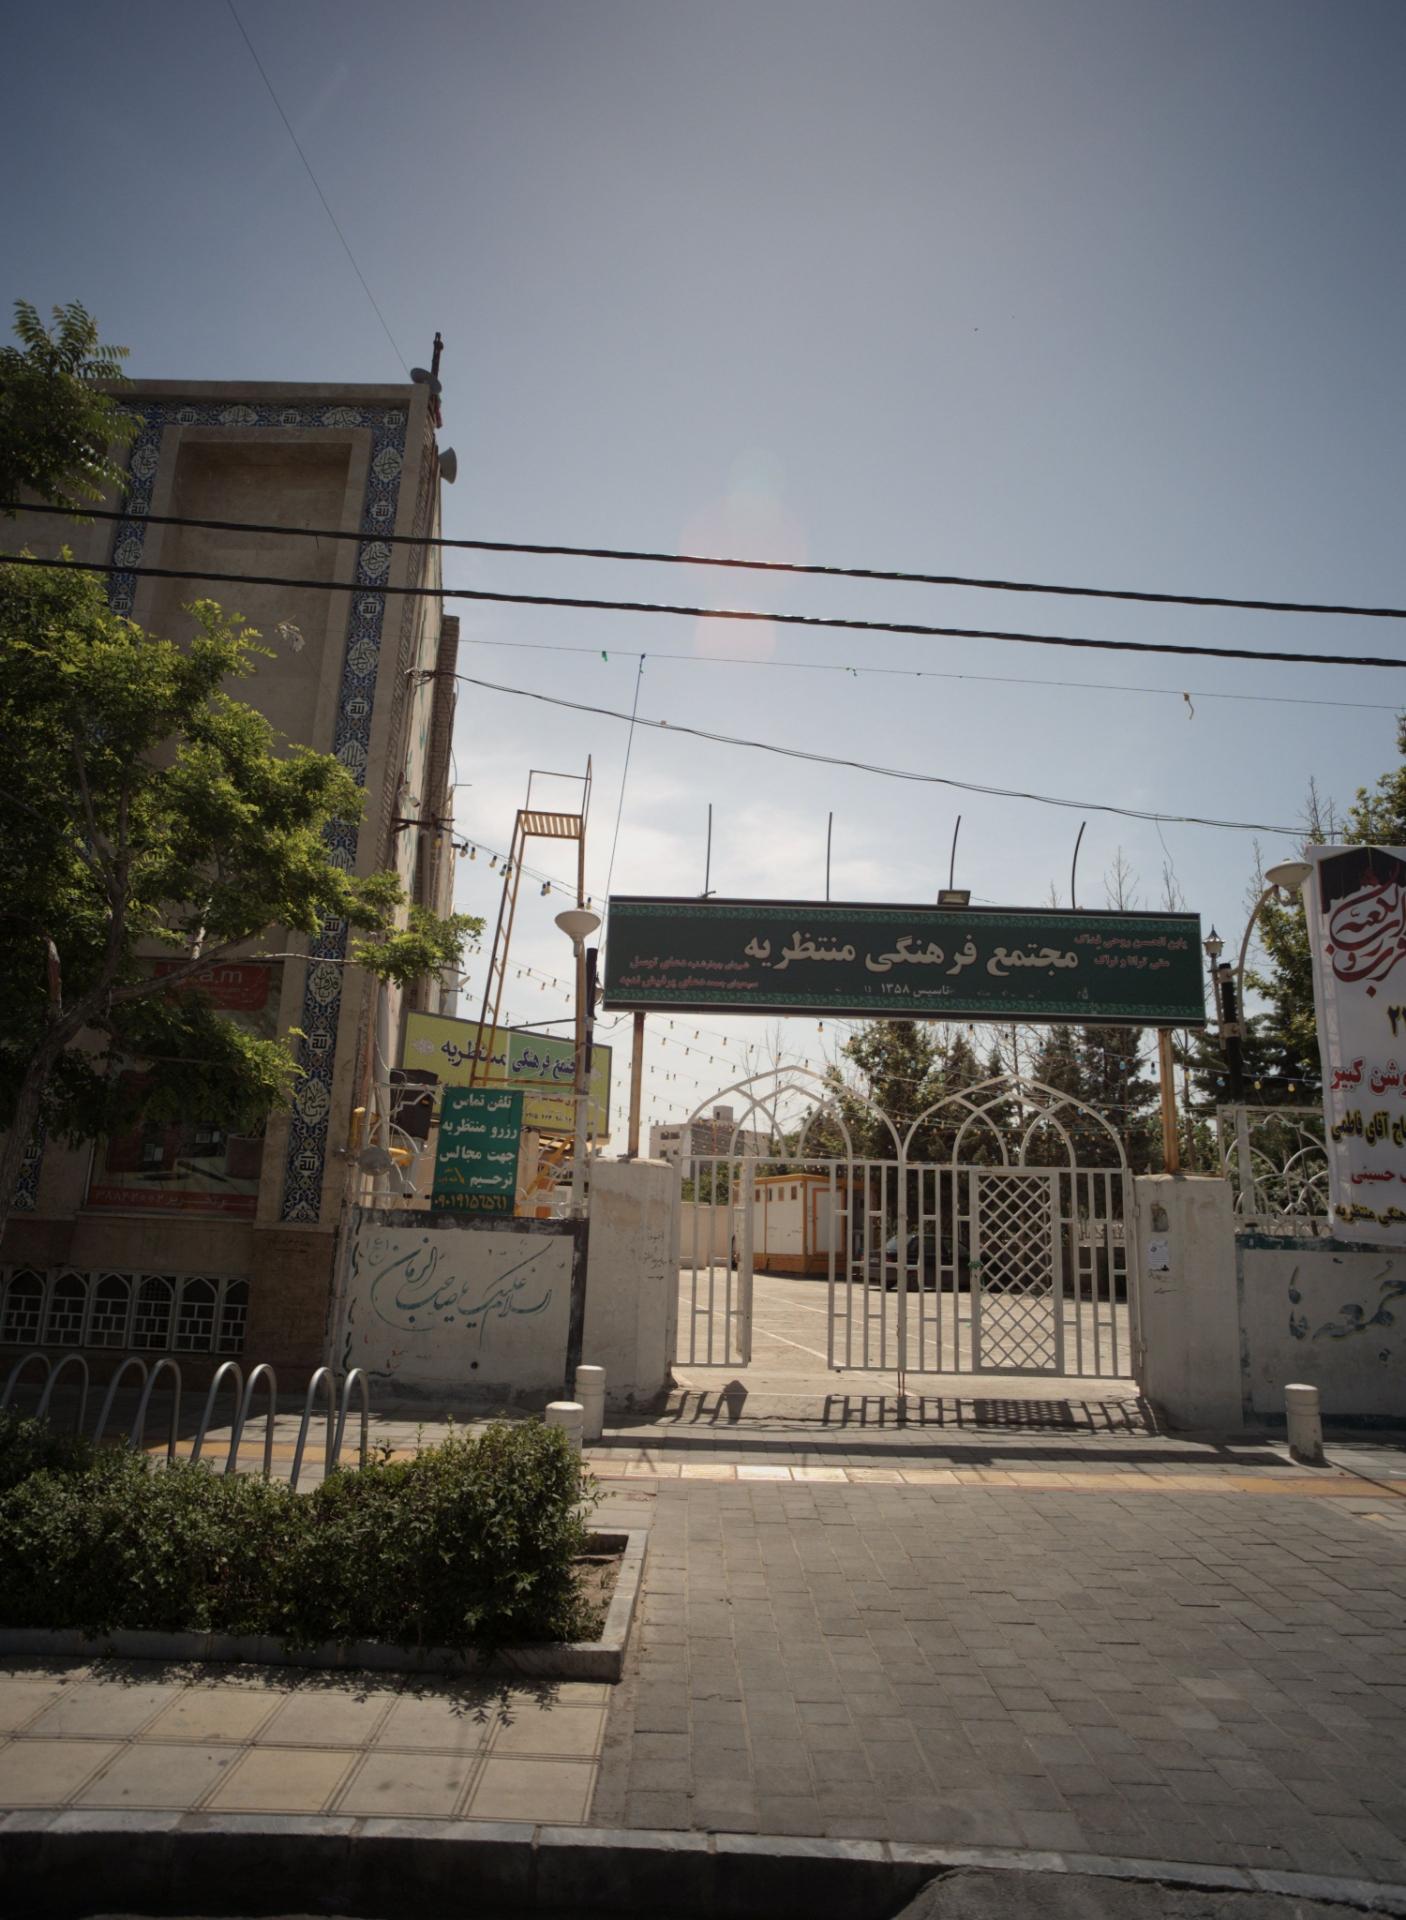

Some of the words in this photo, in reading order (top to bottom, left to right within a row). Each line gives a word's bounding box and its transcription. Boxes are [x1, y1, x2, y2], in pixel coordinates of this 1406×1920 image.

[744, 931, 857, 970] منتظریه
[1103, 938, 1131, 949] روحی
[1133, 936, 1167, 949] الحسن
[865, 934, 977, 975] فرهنگی
[986, 942, 1078, 976] مجتمع
[881, 984, 910, 995] ۱۳۵۸
[913, 984, 950, 997] تاسیس
[441, 1040, 506, 1067] منتظریه
[512, 1047, 550, 1076] فرهنگی
[1331, 1060, 1363, 1089] کبیر
[452, 1094, 485, 1110] تماس
[487, 1093, 512, 1111] تلفن
[442, 1118, 487, 1137] منتظریه
[490, 1124, 518, 1140] رزرو
[1331, 1109, 1363, 1141] فاطمی
[1365, 1109, 1390, 1147] آقای
[439, 1146, 482, 1162] مجالس
[486, 1151, 516, 1162] جهت
[469, 1172, 514, 1189] ترحیم
[1351, 1165, 1395, 1185] حسینی
